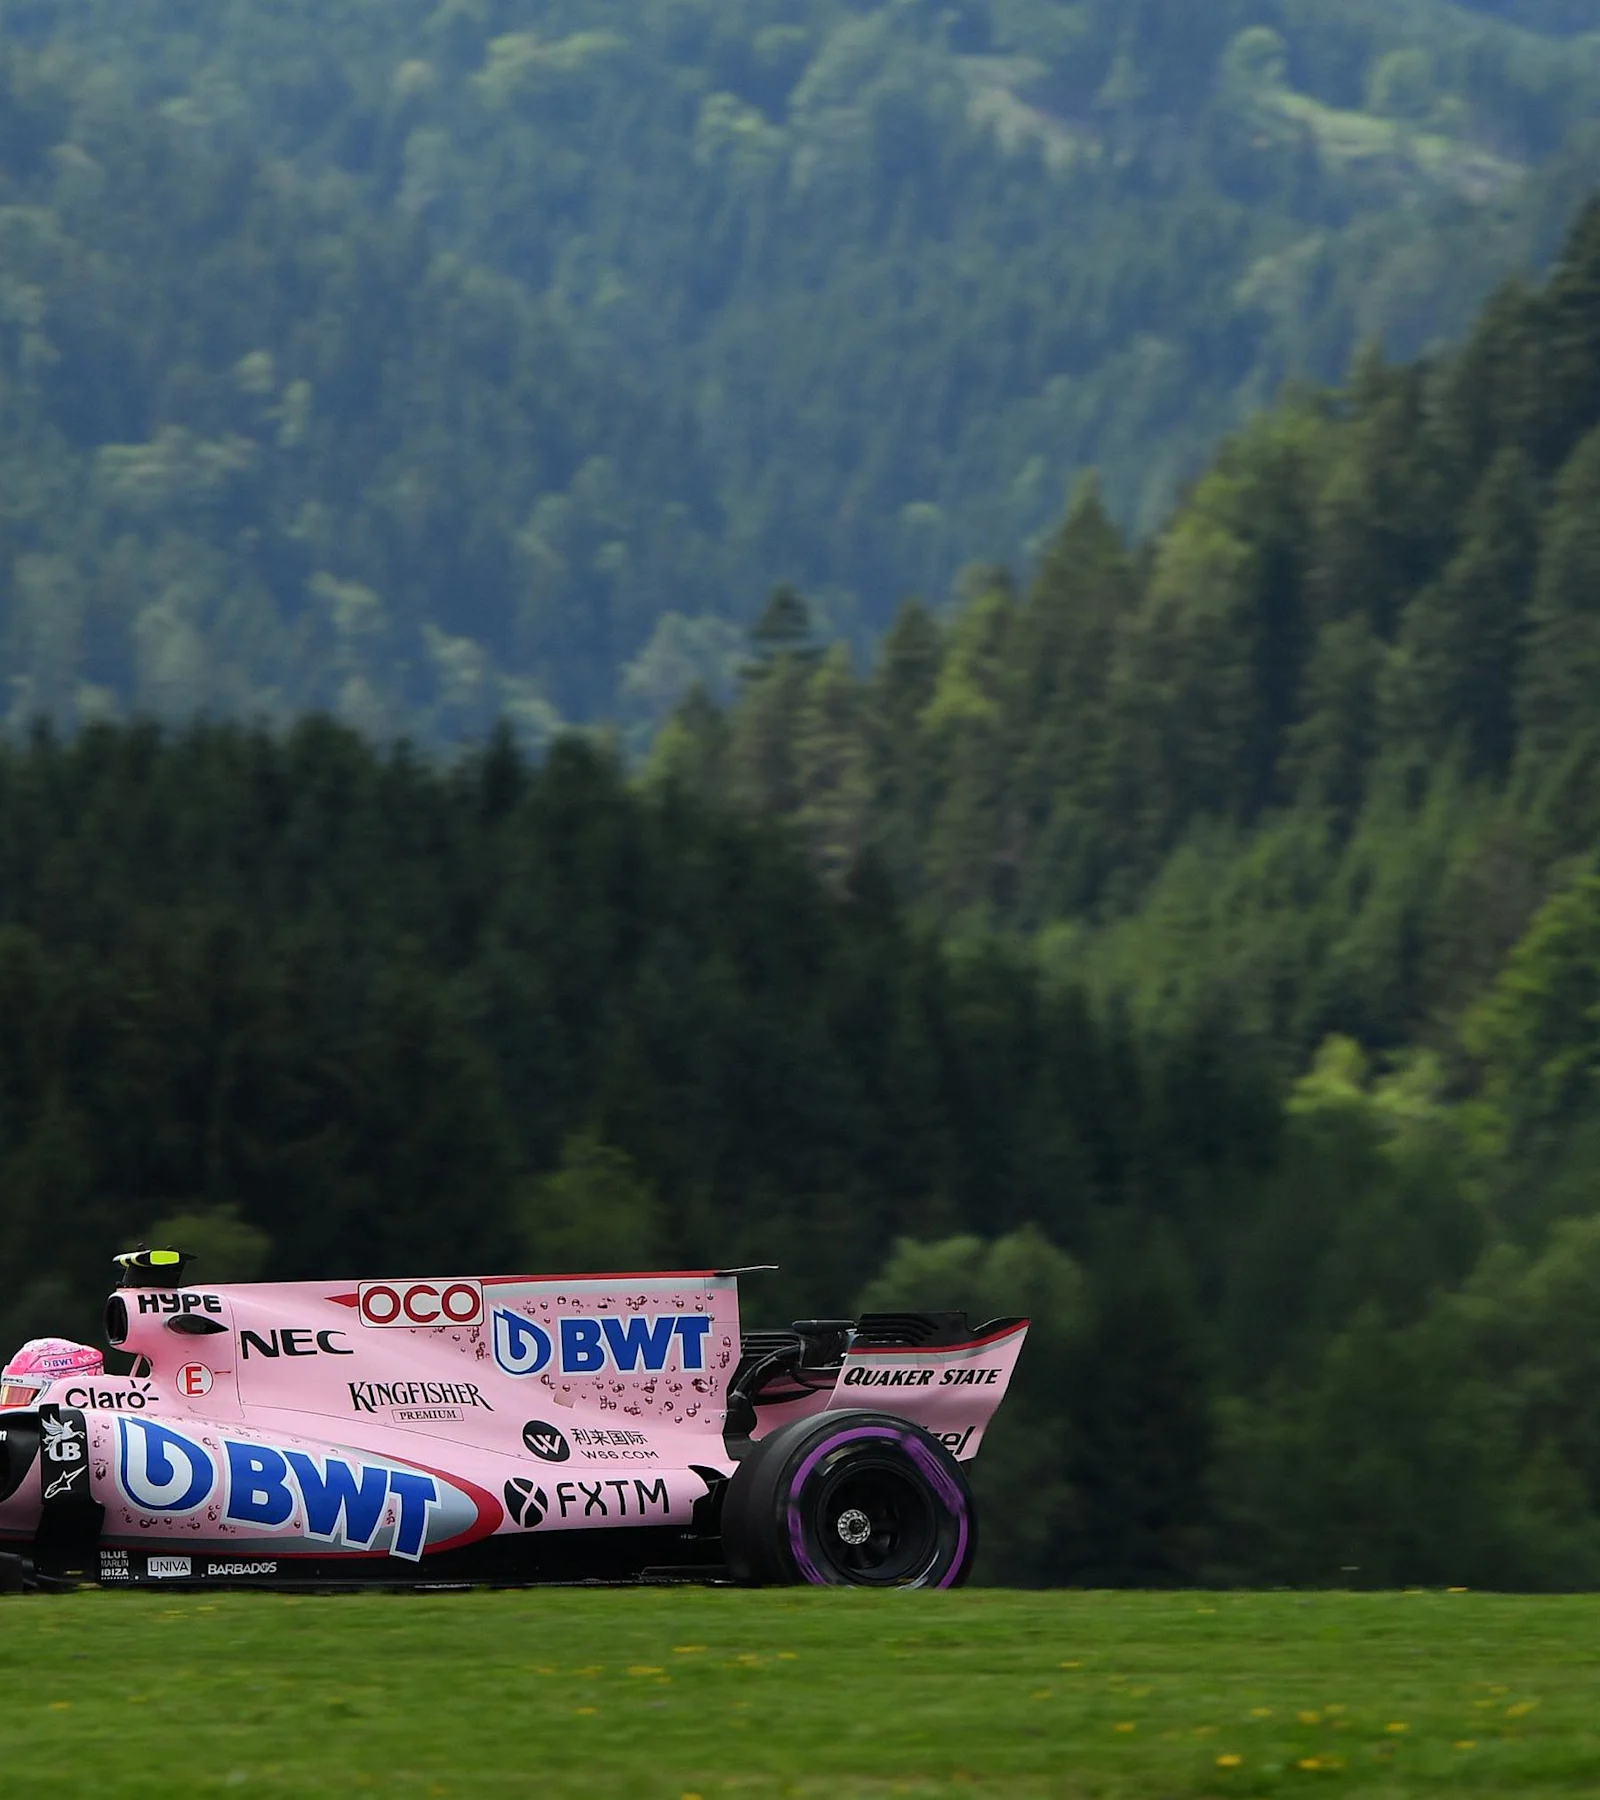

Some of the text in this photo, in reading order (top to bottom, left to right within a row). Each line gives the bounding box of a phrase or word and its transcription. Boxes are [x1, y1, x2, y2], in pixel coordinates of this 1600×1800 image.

[137, 1293, 222, 1313] HYPE
[240, 1329, 353, 1359] NEC
[559, 1315, 711, 1374] BWT
[52, 1358, 74, 1367] BWT
[77, 1352, 99, 1364] NEC
[185, 1366, 204, 1395] E
[843, 1367, 1002, 1386] QUAKER STATE
[65, 1387, 147, 1409] Claro
[346, 1381, 495, 1413] KINGFISHER
[399, 1410, 457, 1421] PREMIUM
[570, 1428, 648, 1446] 利来国际
[581, 1450, 660, 1460] W66.COM
[223, 1438, 441, 1560] BWT
[556, 1478, 670, 1518] FXTM
[100, 1550, 128, 1559] BLUE
[101, 1559, 129, 1567] MARLIN
[101, 1568, 129, 1576] IBIZA
[150, 1560, 188, 1572] UNIVA
[207, 1562, 277, 1575] BARBADOS
